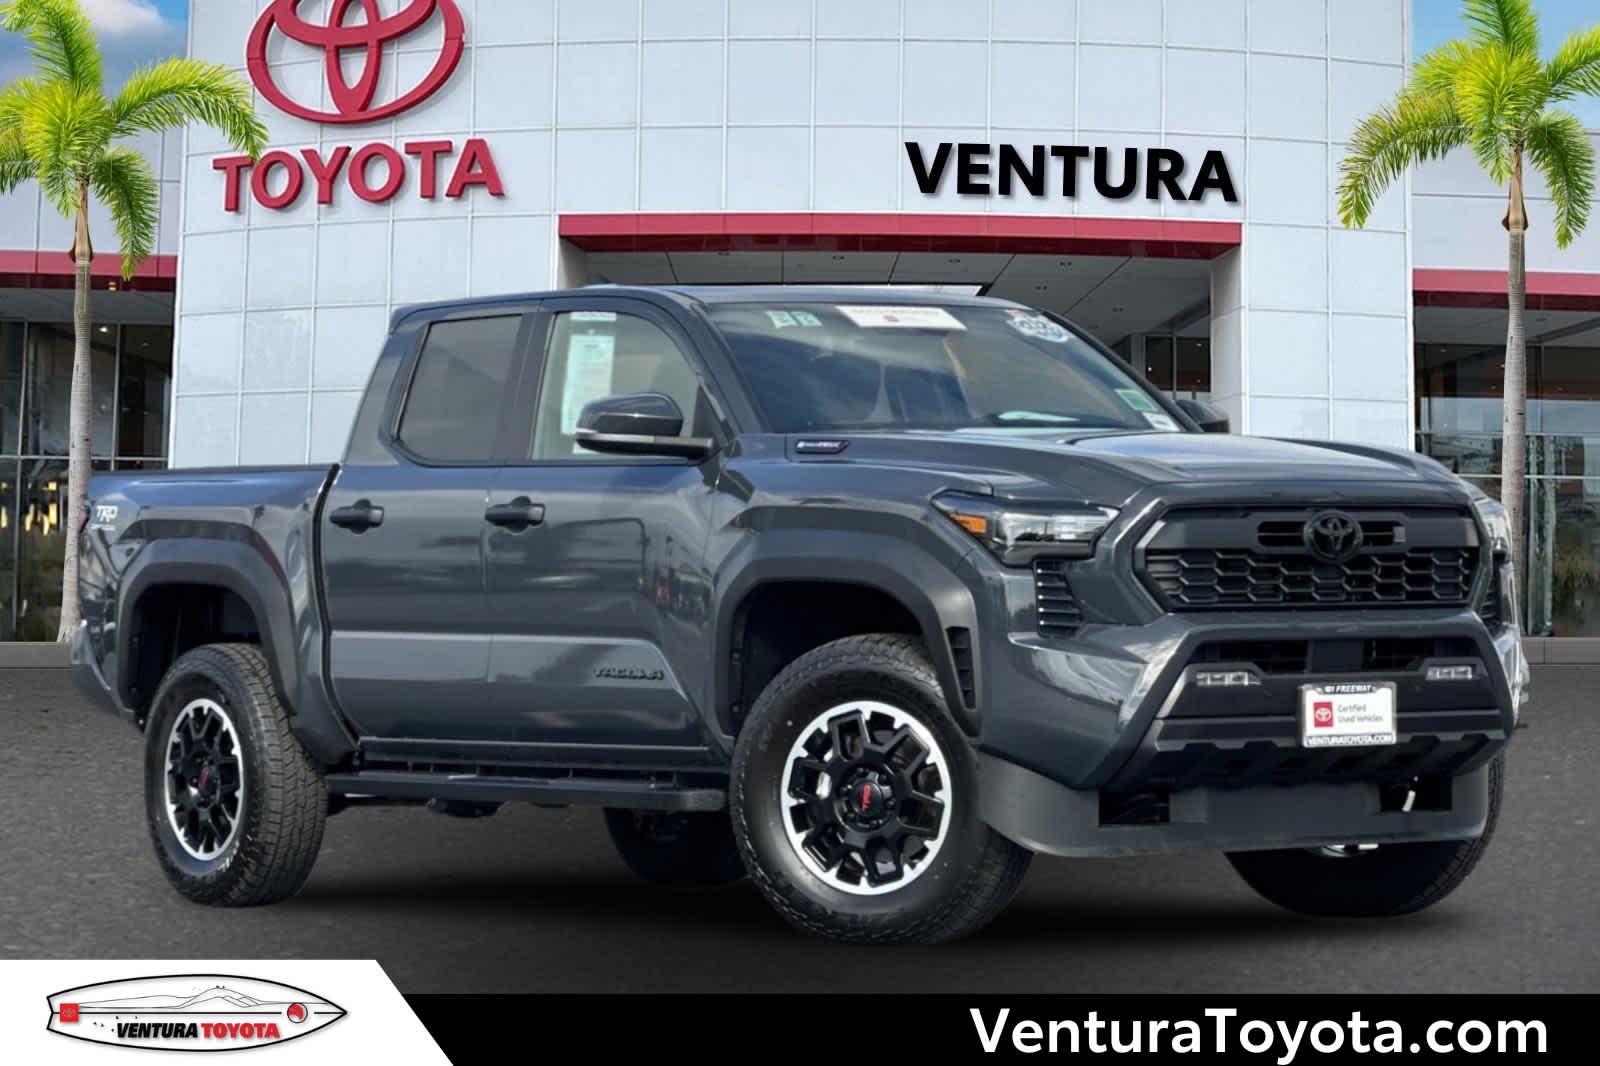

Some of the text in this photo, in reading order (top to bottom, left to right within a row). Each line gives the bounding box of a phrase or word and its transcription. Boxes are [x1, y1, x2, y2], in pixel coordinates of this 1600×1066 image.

[212, 138, 505, 212] TOYOTA
[904, 141, 1238, 203] VENTURA
[1337, 704, 1367, 713] Certified
